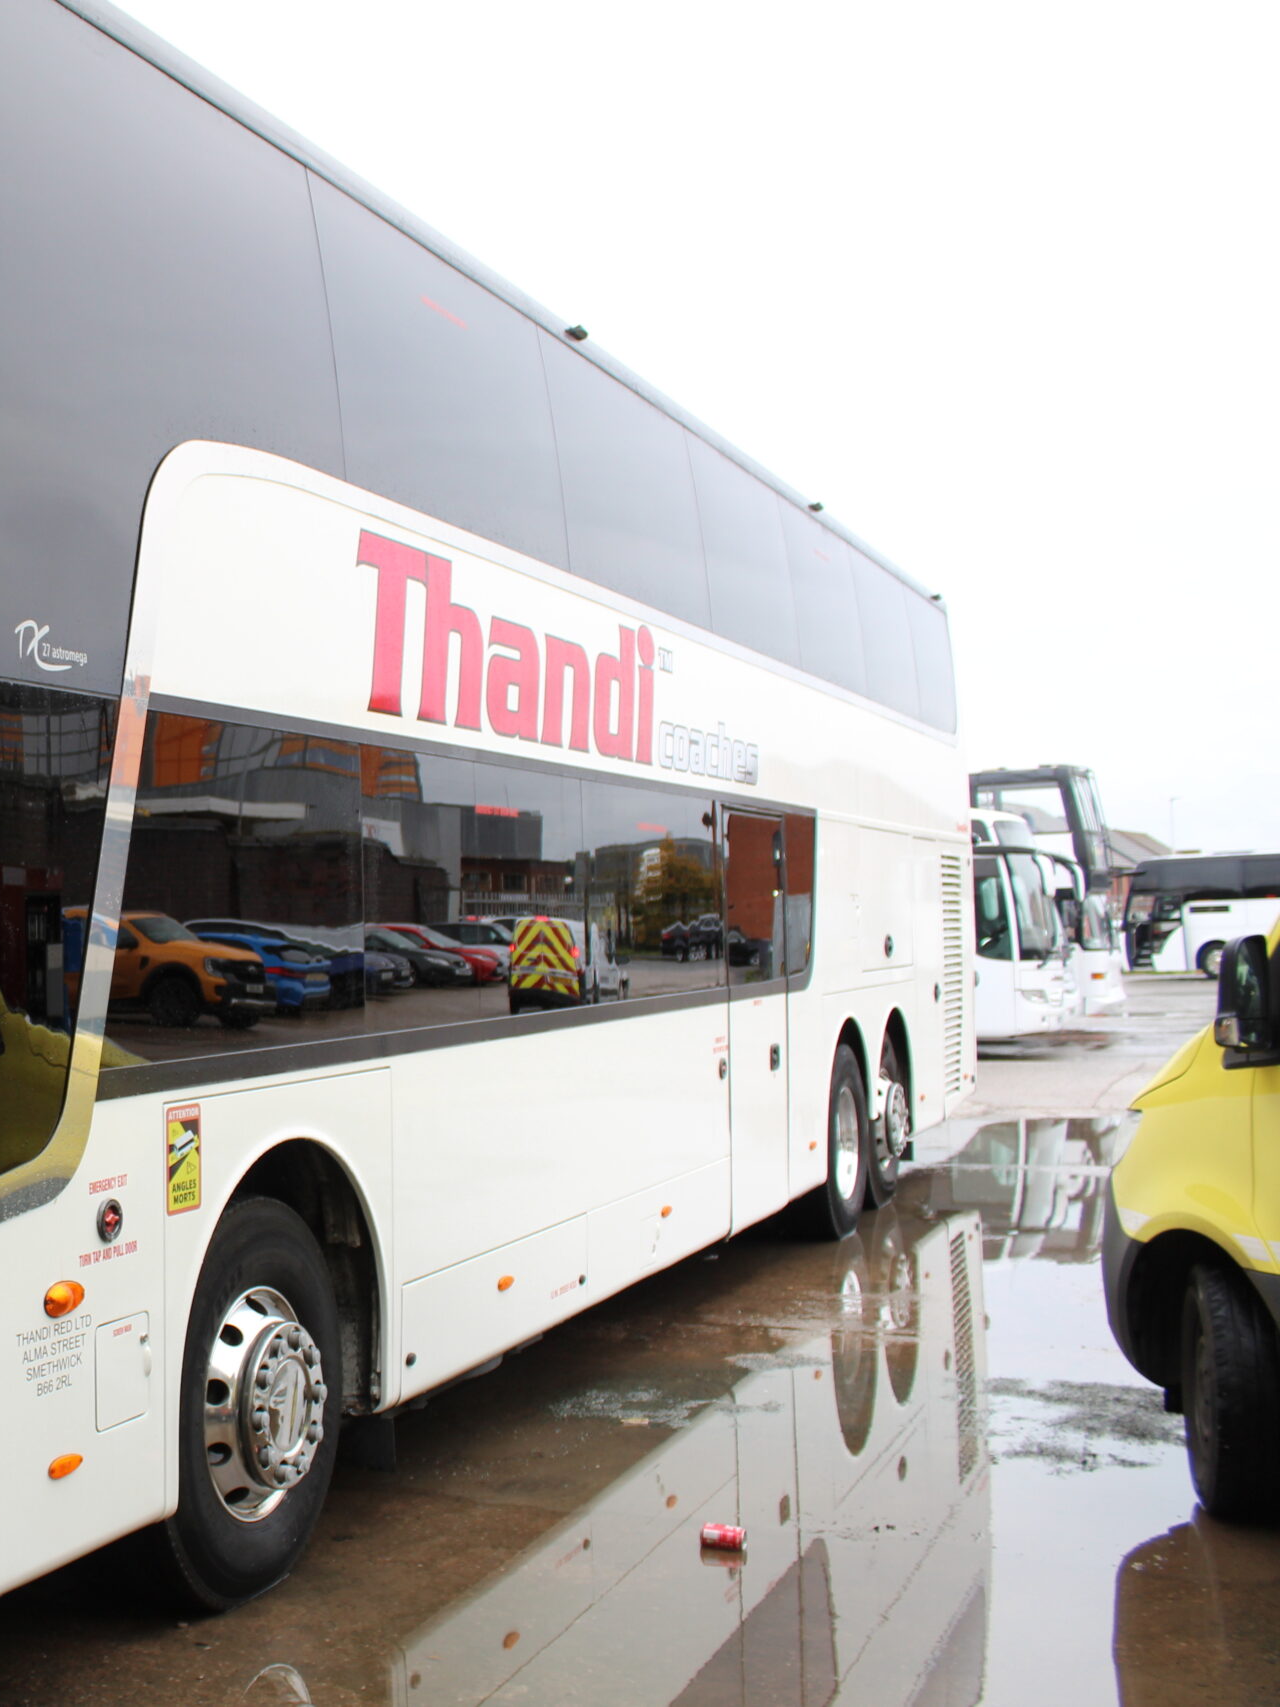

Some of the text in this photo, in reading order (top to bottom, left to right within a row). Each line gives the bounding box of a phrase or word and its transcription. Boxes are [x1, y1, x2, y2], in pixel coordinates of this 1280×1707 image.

[42, 643, 51, 657] 27
[52, 646, 88, 667] astromega
[356, 528, 655, 766] Thandi
[658, 721, 759, 786] coaches
[168, 1107, 199, 1121] ATTENTION
[89, 1173, 128, 1195] EMERGENCY EXIT
[172, 1179, 197, 1193] ANGLES
[173, 1191, 196, 1205] MORTS
[79, 1240, 138, 1267] TURN TAP AND PULL DOOR
[16, 1326, 51, 1347] THANDI
[53, 1319, 73, 1337] RED
[75, 1314, 93, 1332] LTD
[22, 1333, 86, 1365] ALMA STREET
[26, 1352, 83, 1382] SMETHWICK
[37, 1373, 73, 1397] B66 2RL
